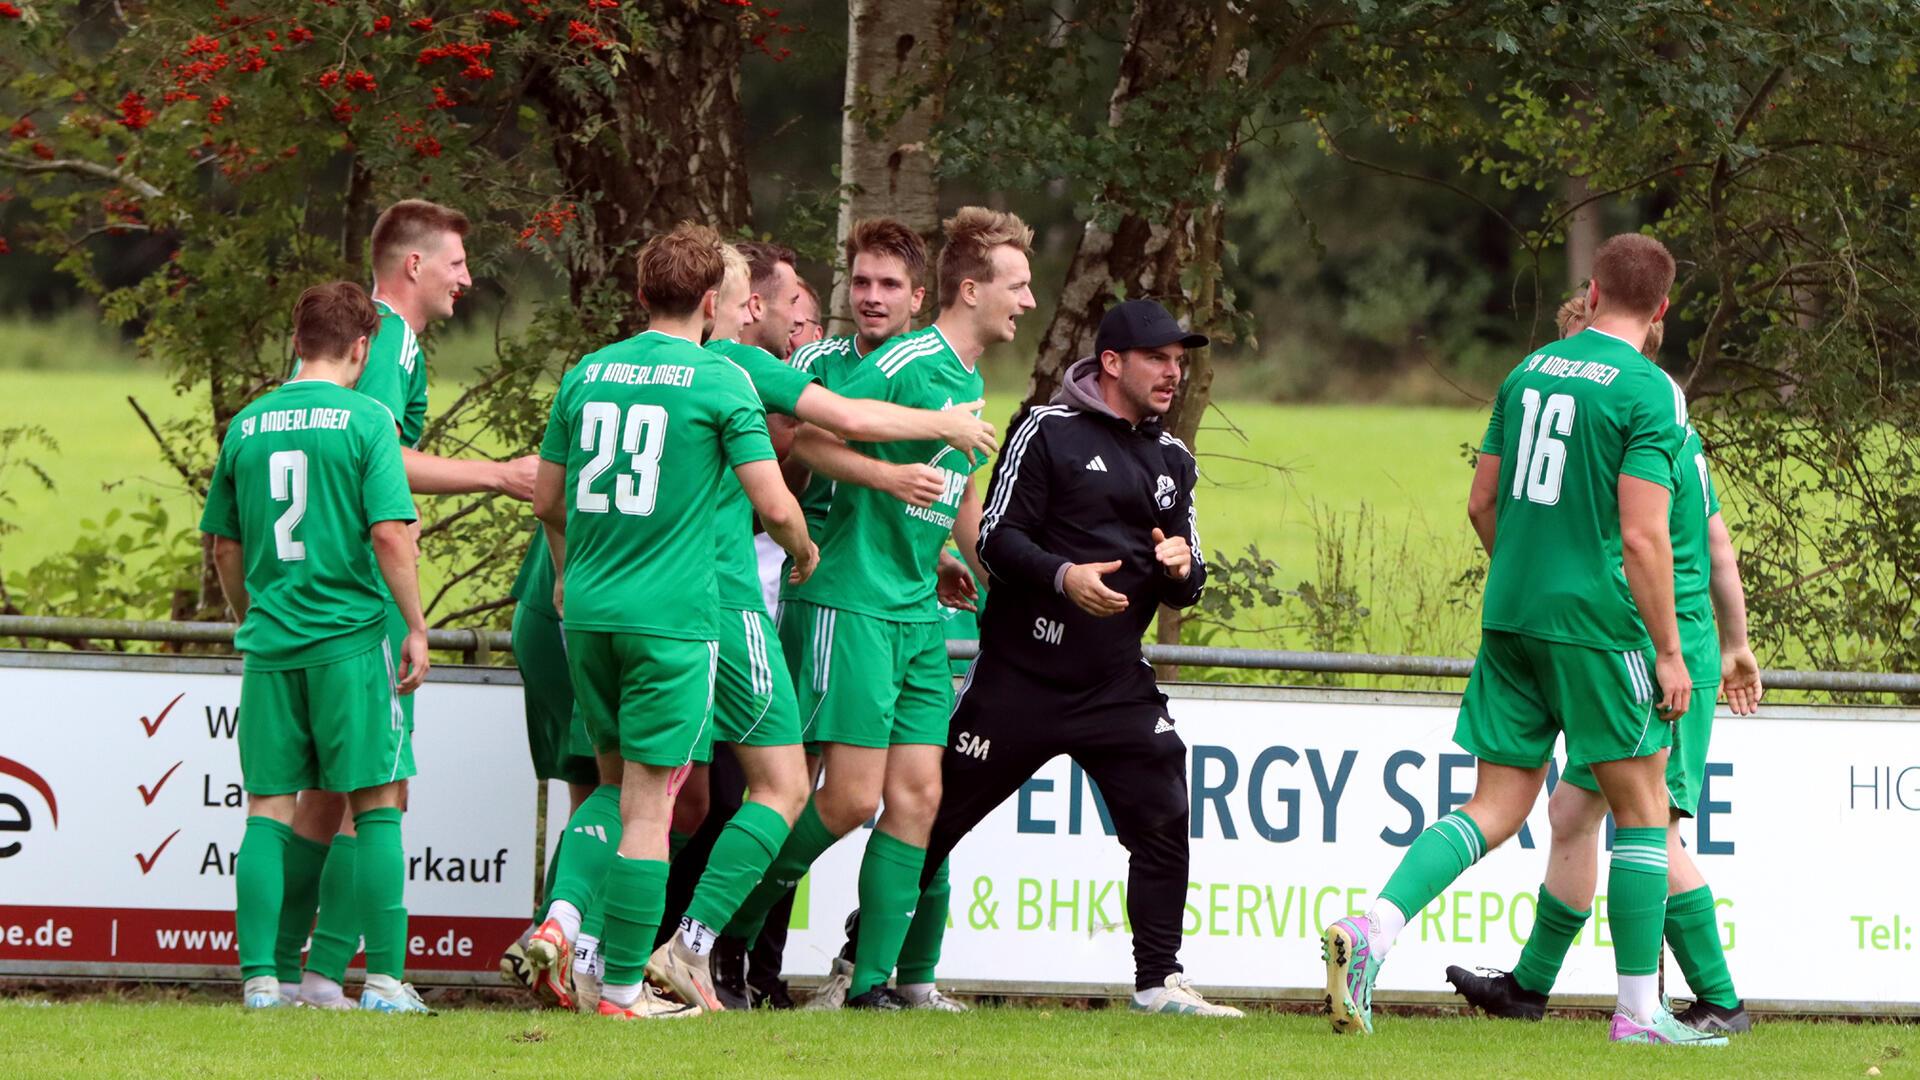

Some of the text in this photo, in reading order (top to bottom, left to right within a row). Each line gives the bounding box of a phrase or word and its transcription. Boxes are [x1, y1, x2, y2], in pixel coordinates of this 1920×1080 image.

[583, 363, 696, 388] SV ANDERLINGEN
[1538, 355, 1621, 387] ANDERLINGEN
[241, 408, 352, 440] SV ANDERLINGEN
[576, 401, 669, 517] 23
[1511, 387, 1577, 507] 16
[269, 449, 308, 562] 2
[1032, 616, 1065, 645] SM
[955, 731, 991, 761] SM
[967, 876, 1000, 931] &
[1850, 914, 1912, 951] Tel:
